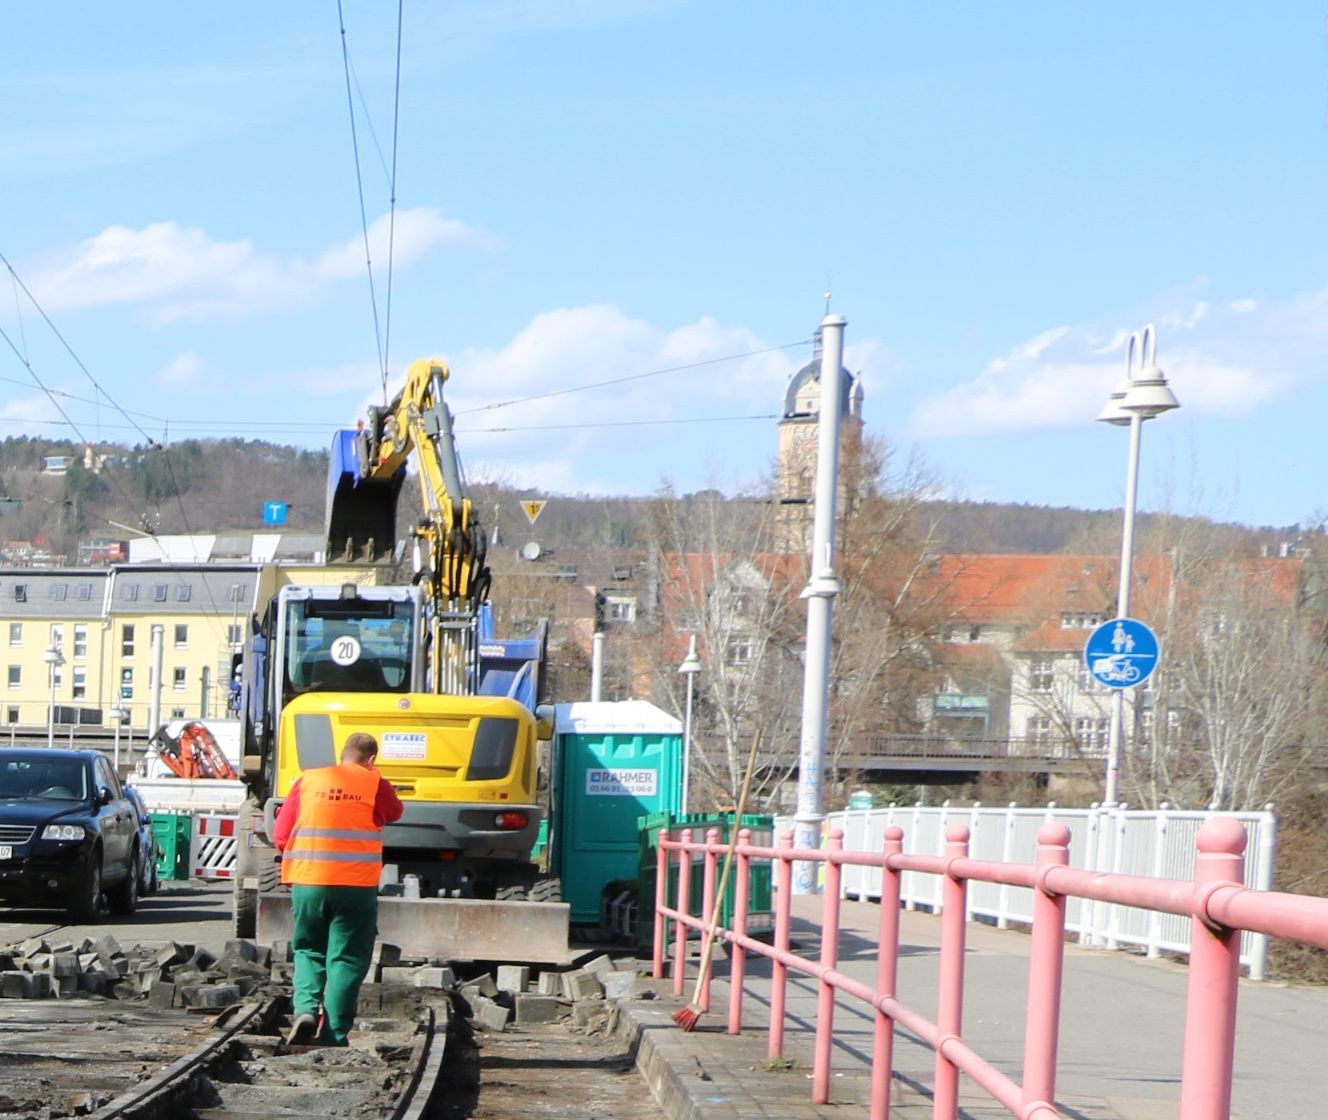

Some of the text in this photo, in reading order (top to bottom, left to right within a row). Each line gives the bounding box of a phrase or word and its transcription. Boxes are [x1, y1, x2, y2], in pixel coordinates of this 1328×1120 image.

[269, 504, 281, 520] T
[338, 642, 354, 659] 20
[602, 772, 653, 782] RAHMER
